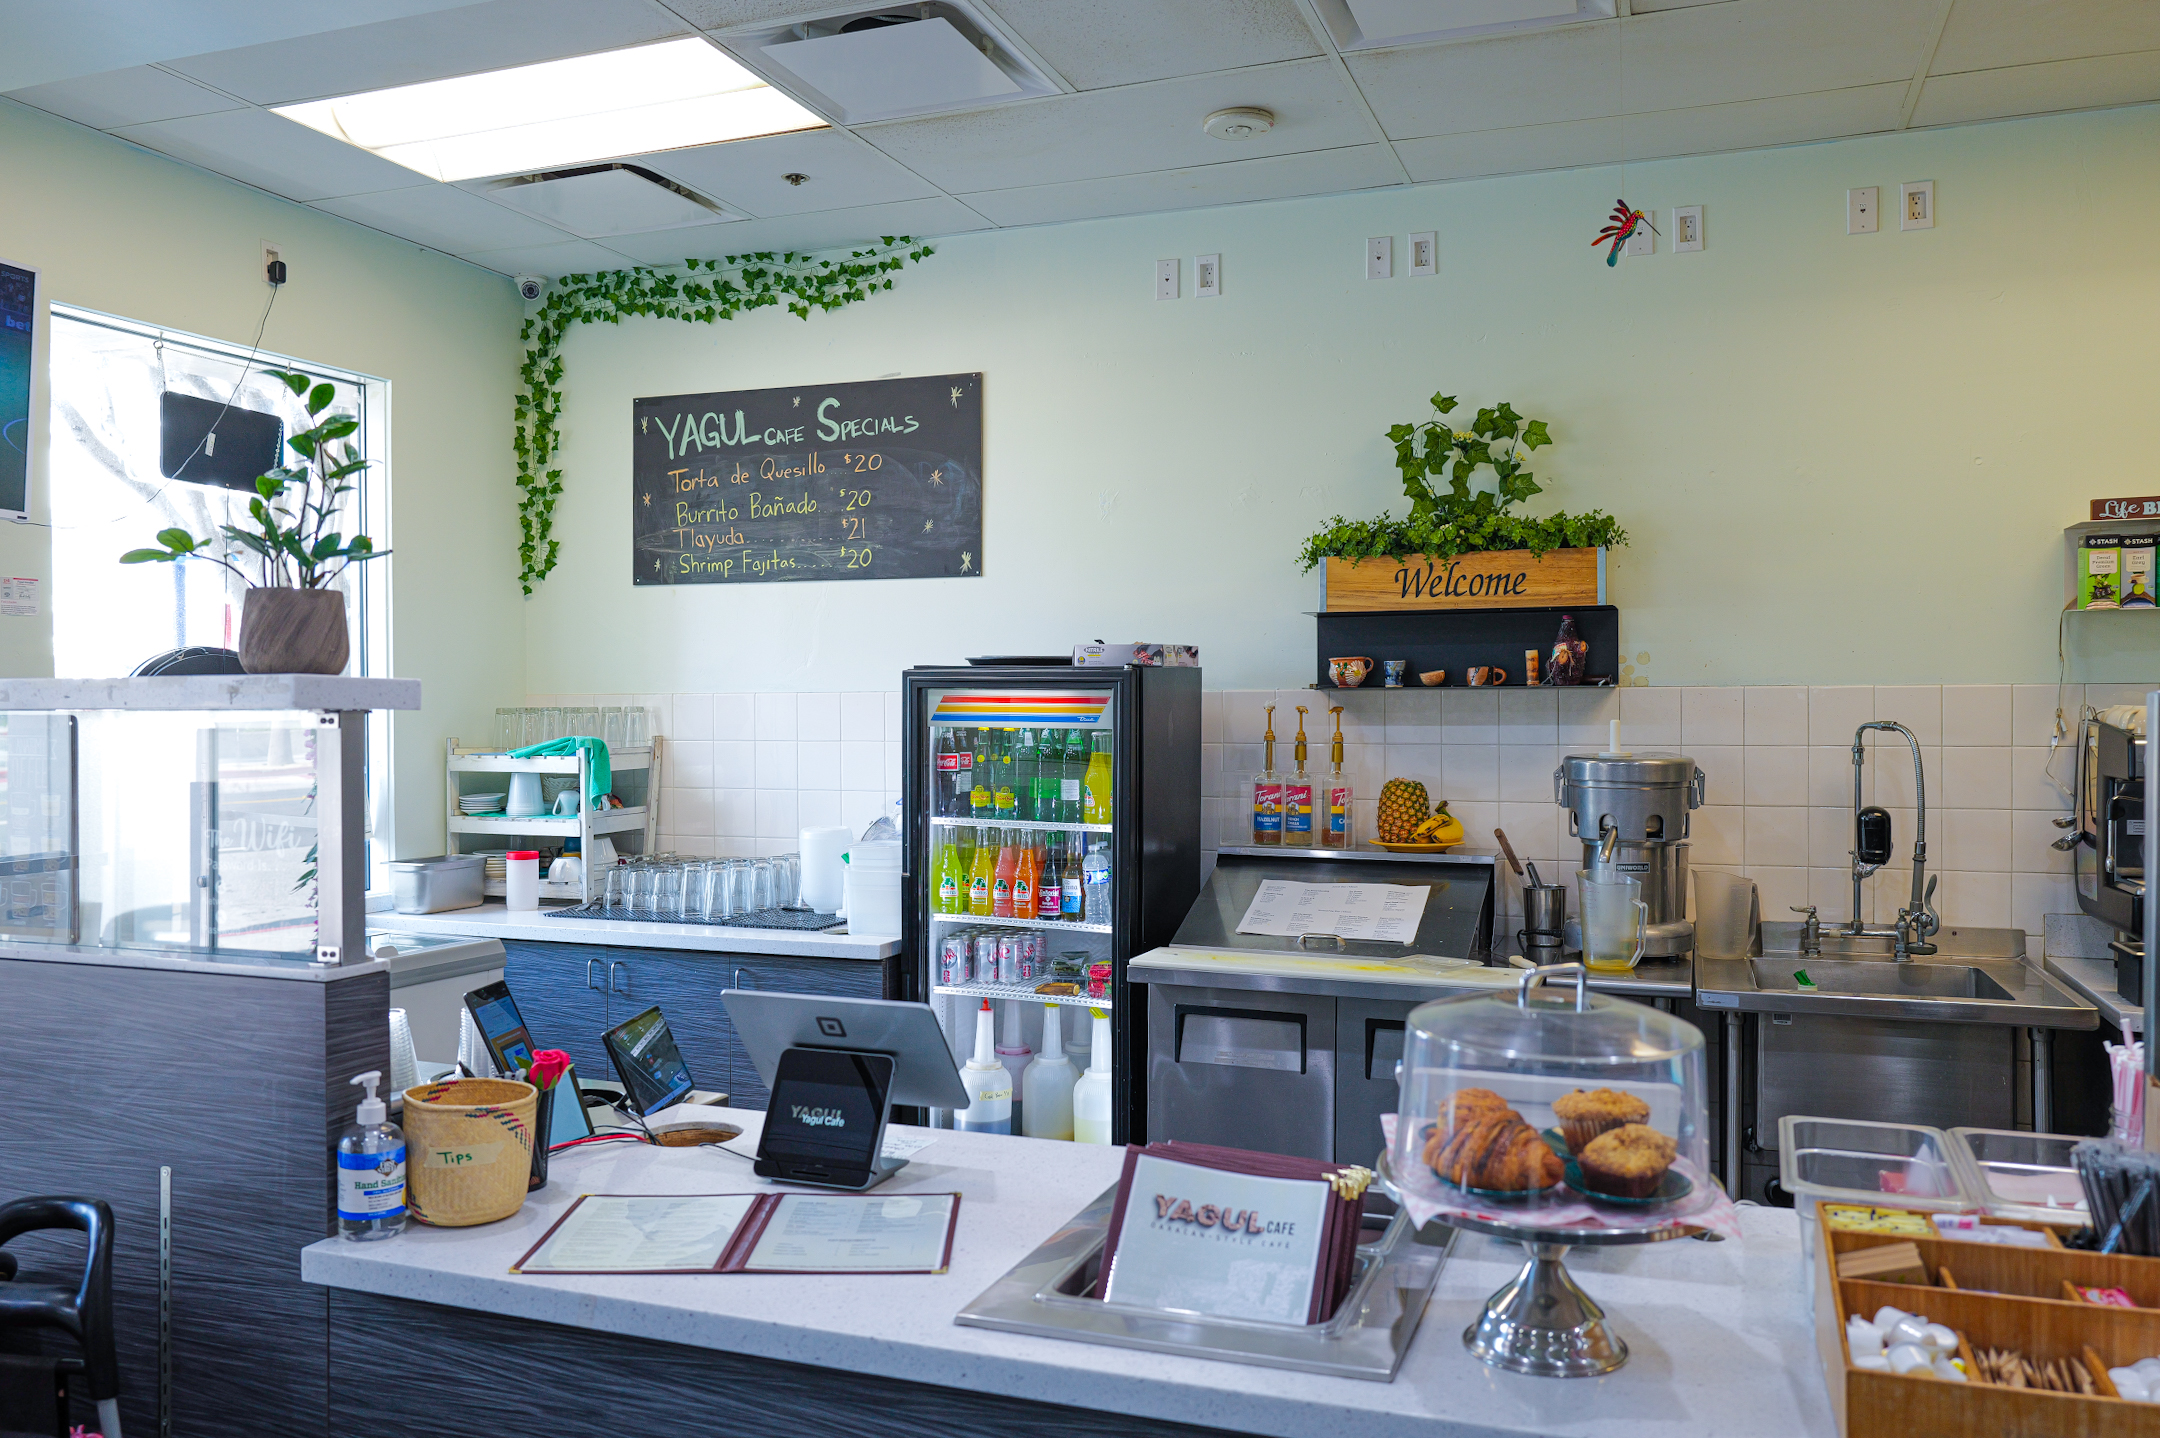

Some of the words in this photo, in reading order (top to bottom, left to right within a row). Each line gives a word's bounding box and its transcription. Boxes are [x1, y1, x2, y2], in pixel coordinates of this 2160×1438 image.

[655, 410, 761, 460] YAGUL
[764, 426, 805, 446] CAFE
[816, 397, 920, 442] SPECIALS
[668, 467, 719, 495] Torta
[730, 462, 750, 486] de
[760, 451, 826, 481] Quesillo
[844, 453, 883, 473] $20
[676, 499, 739, 528] Burrito
[750, 491, 818, 520] Bañado
[839, 488, 872, 512] $20
[2099, 500, 2141, 519] Life
[672, 527, 745, 553] Tlayuda
[842, 517, 866, 540] $21
[680, 551, 734, 577] Shrimp
[742, 550, 797, 577] Fajitas
[840, 546, 873, 568] $20
[1395, 561, 1528, 600] Welcome
[1255, 789, 1282, 805] Torani
[233, 817, 302, 859] Wifi
[802, 1113, 825, 1127] Yagul
[824, 1115, 846, 1128] Cafe
[436, 1151, 473, 1165] Tips
[355, 1180, 379, 1190] Hand
[1153, 1193, 1266, 1235] YAGUL
[1266, 1221, 1297, 1236] CAFE
